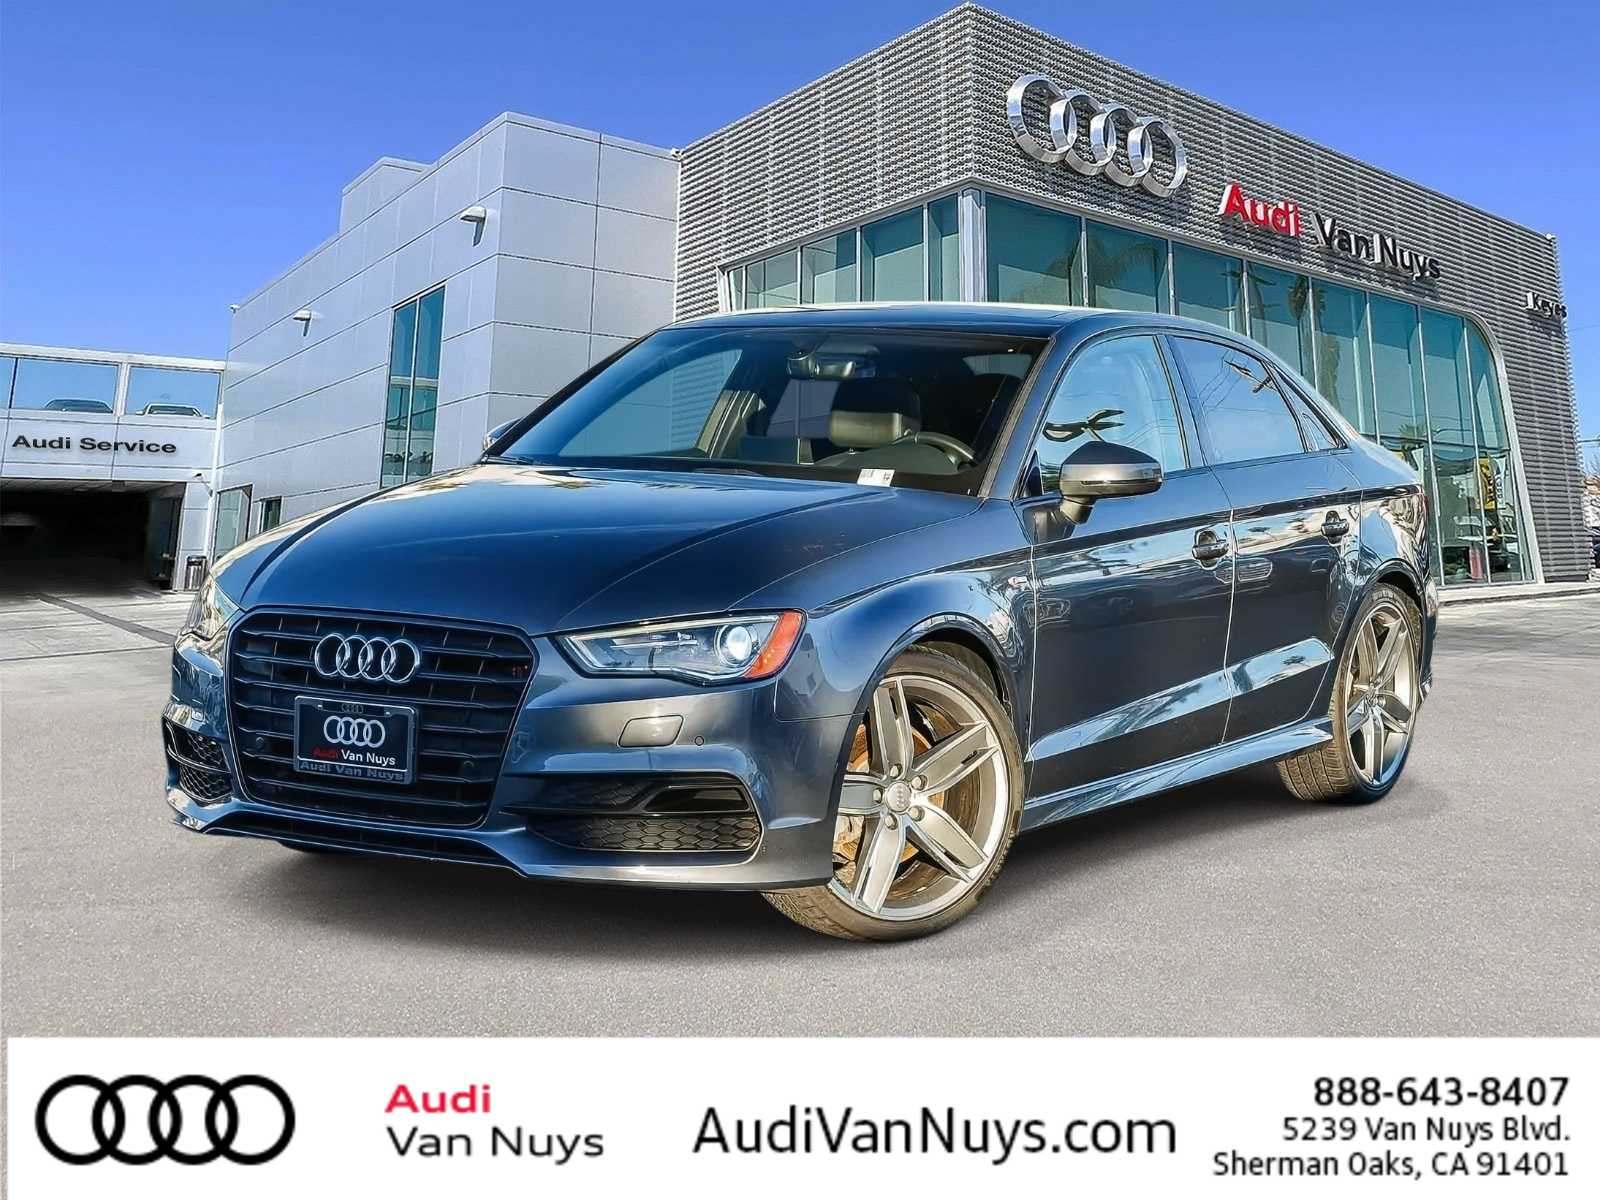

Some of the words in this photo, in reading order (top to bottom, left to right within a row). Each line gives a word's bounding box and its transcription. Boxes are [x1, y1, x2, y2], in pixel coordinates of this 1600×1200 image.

[1217, 183, 1302, 236] Audi
[1311, 213, 1371, 259] Van
[1373, 233, 1440, 281] Nuys
[12, 435, 71, 449] Audi
[79, 438, 177, 453] Service
[341, 748, 363, 762] Van
[366, 752, 396, 767] Nuys
[300, 761, 331, 773] Audi
[336, 765, 362, 777] Van
[366, 769, 405, 782] Nuys
